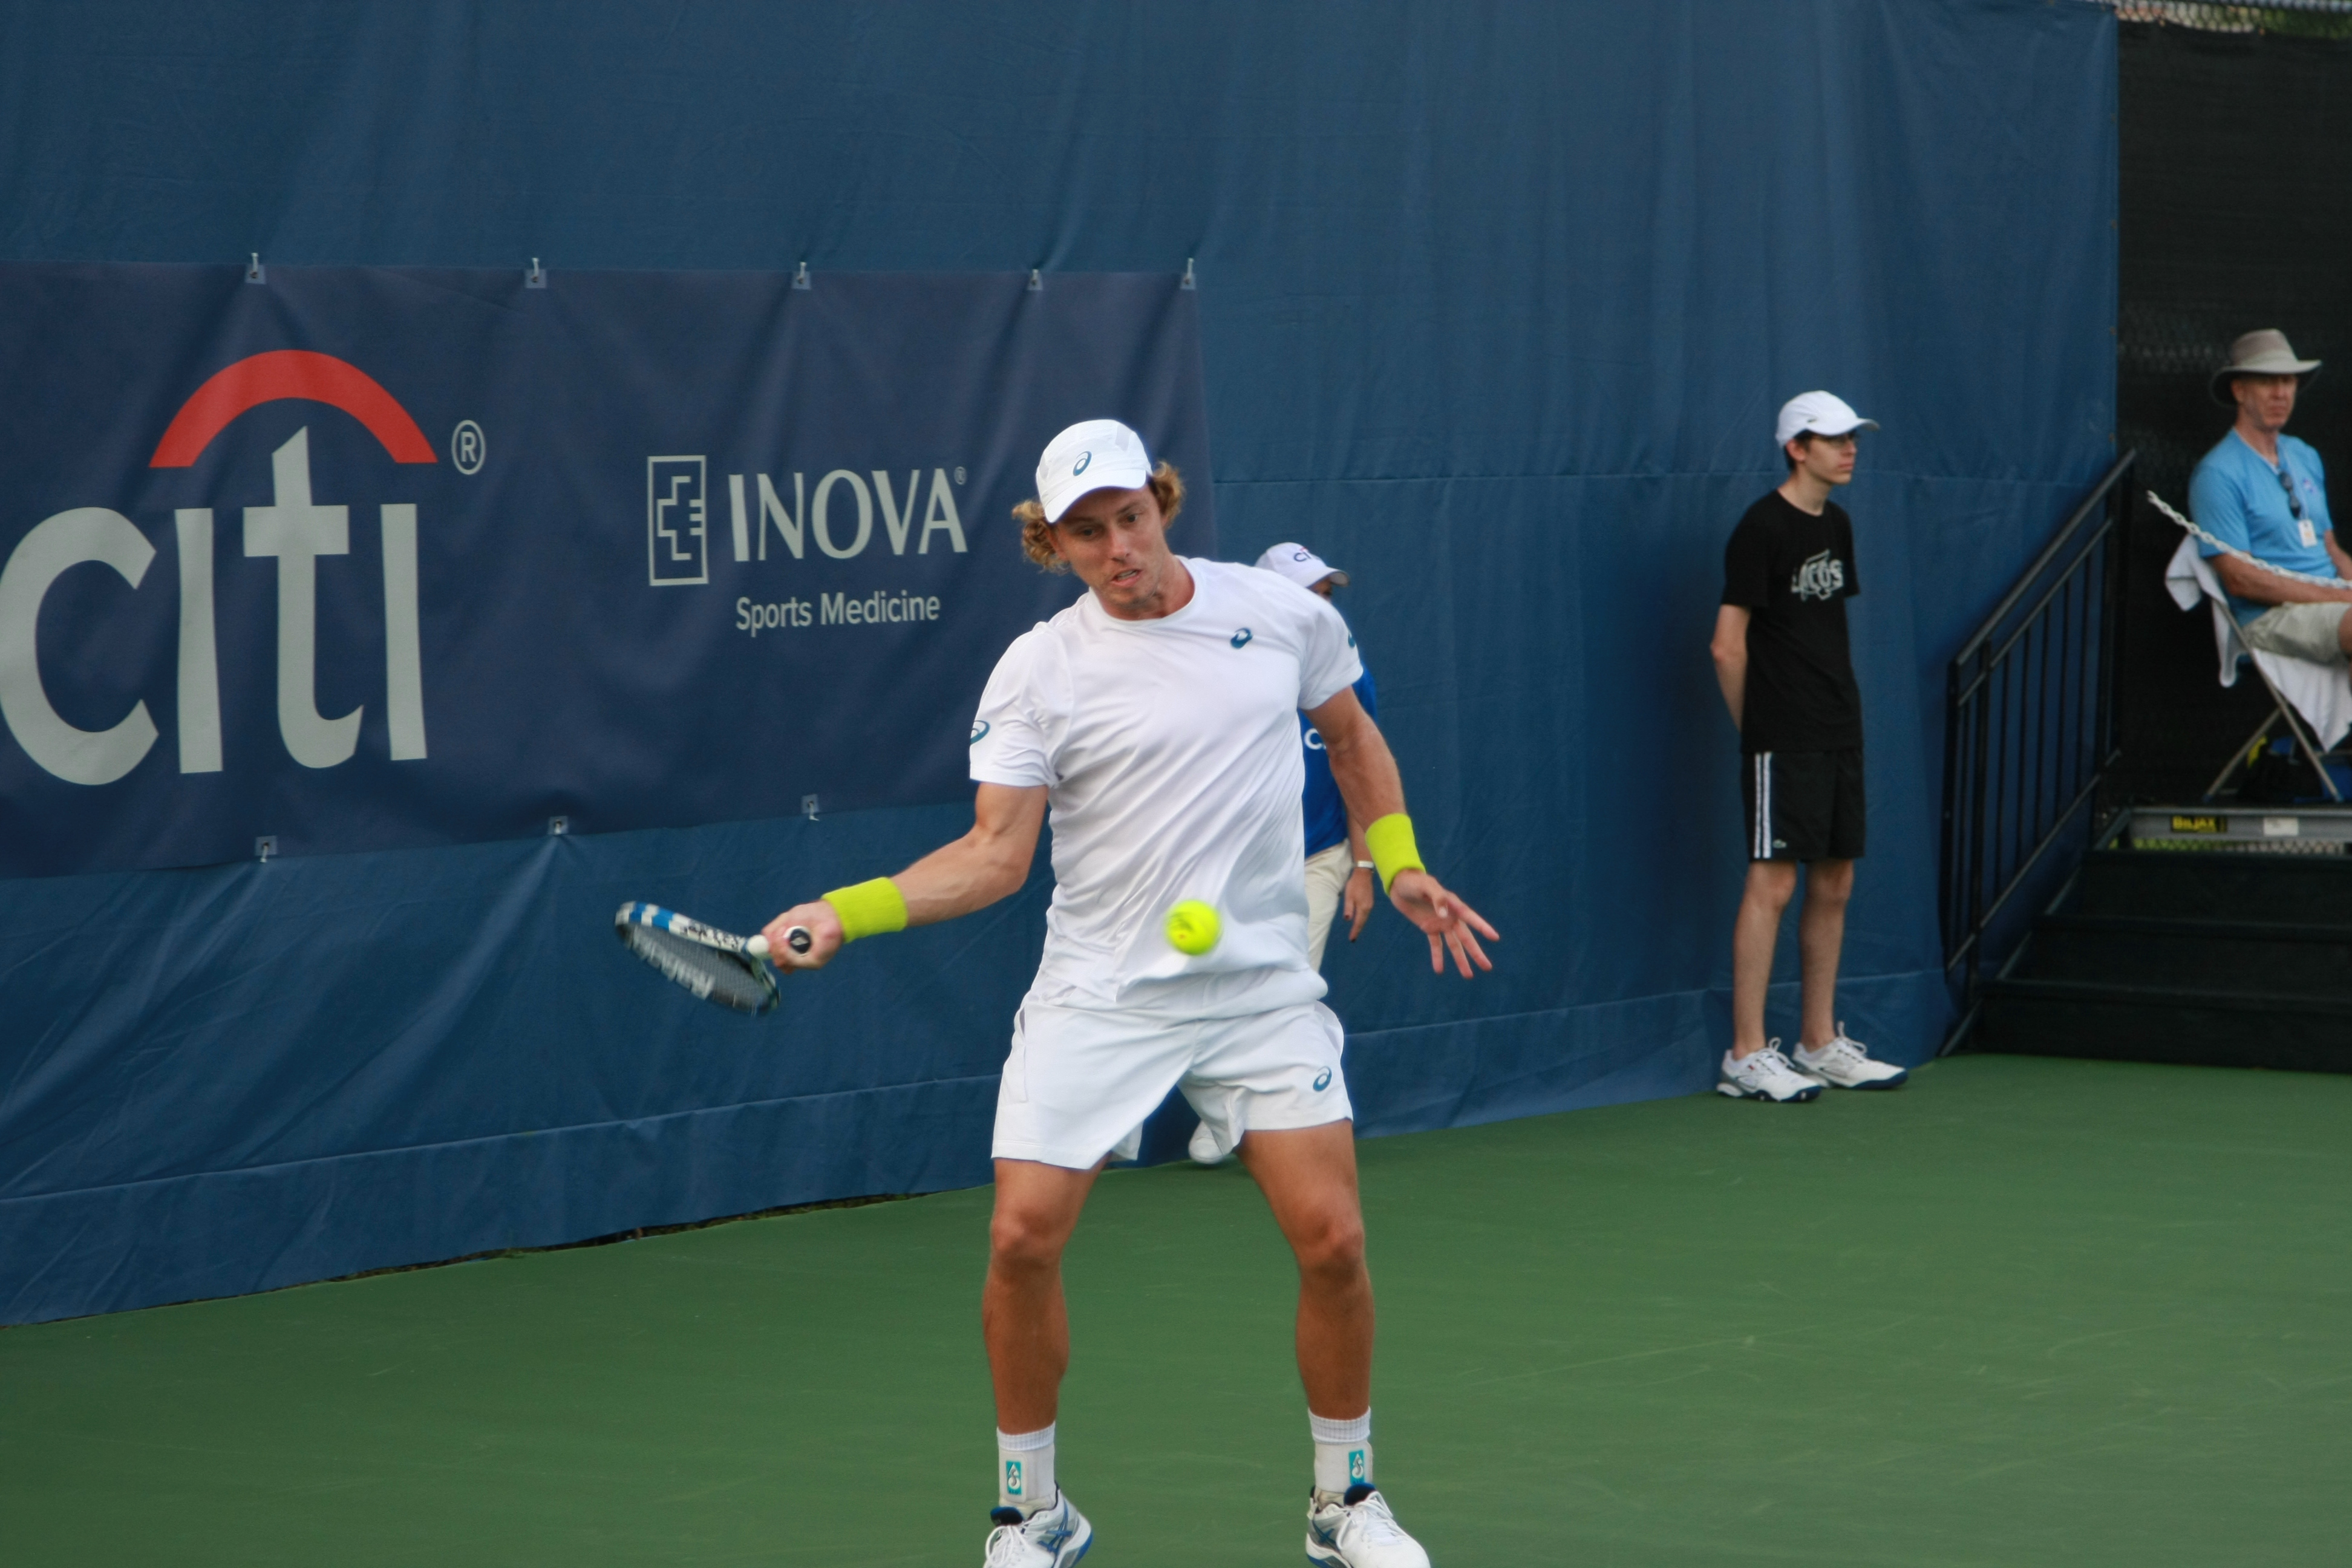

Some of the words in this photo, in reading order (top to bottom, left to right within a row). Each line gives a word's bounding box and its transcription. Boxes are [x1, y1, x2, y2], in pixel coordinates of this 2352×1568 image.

[729, 468, 968, 561] INOVA
[0, 426, 427, 785] citi
[736, 597, 812, 638] Sports
[821, 590, 940, 626] Medicine
